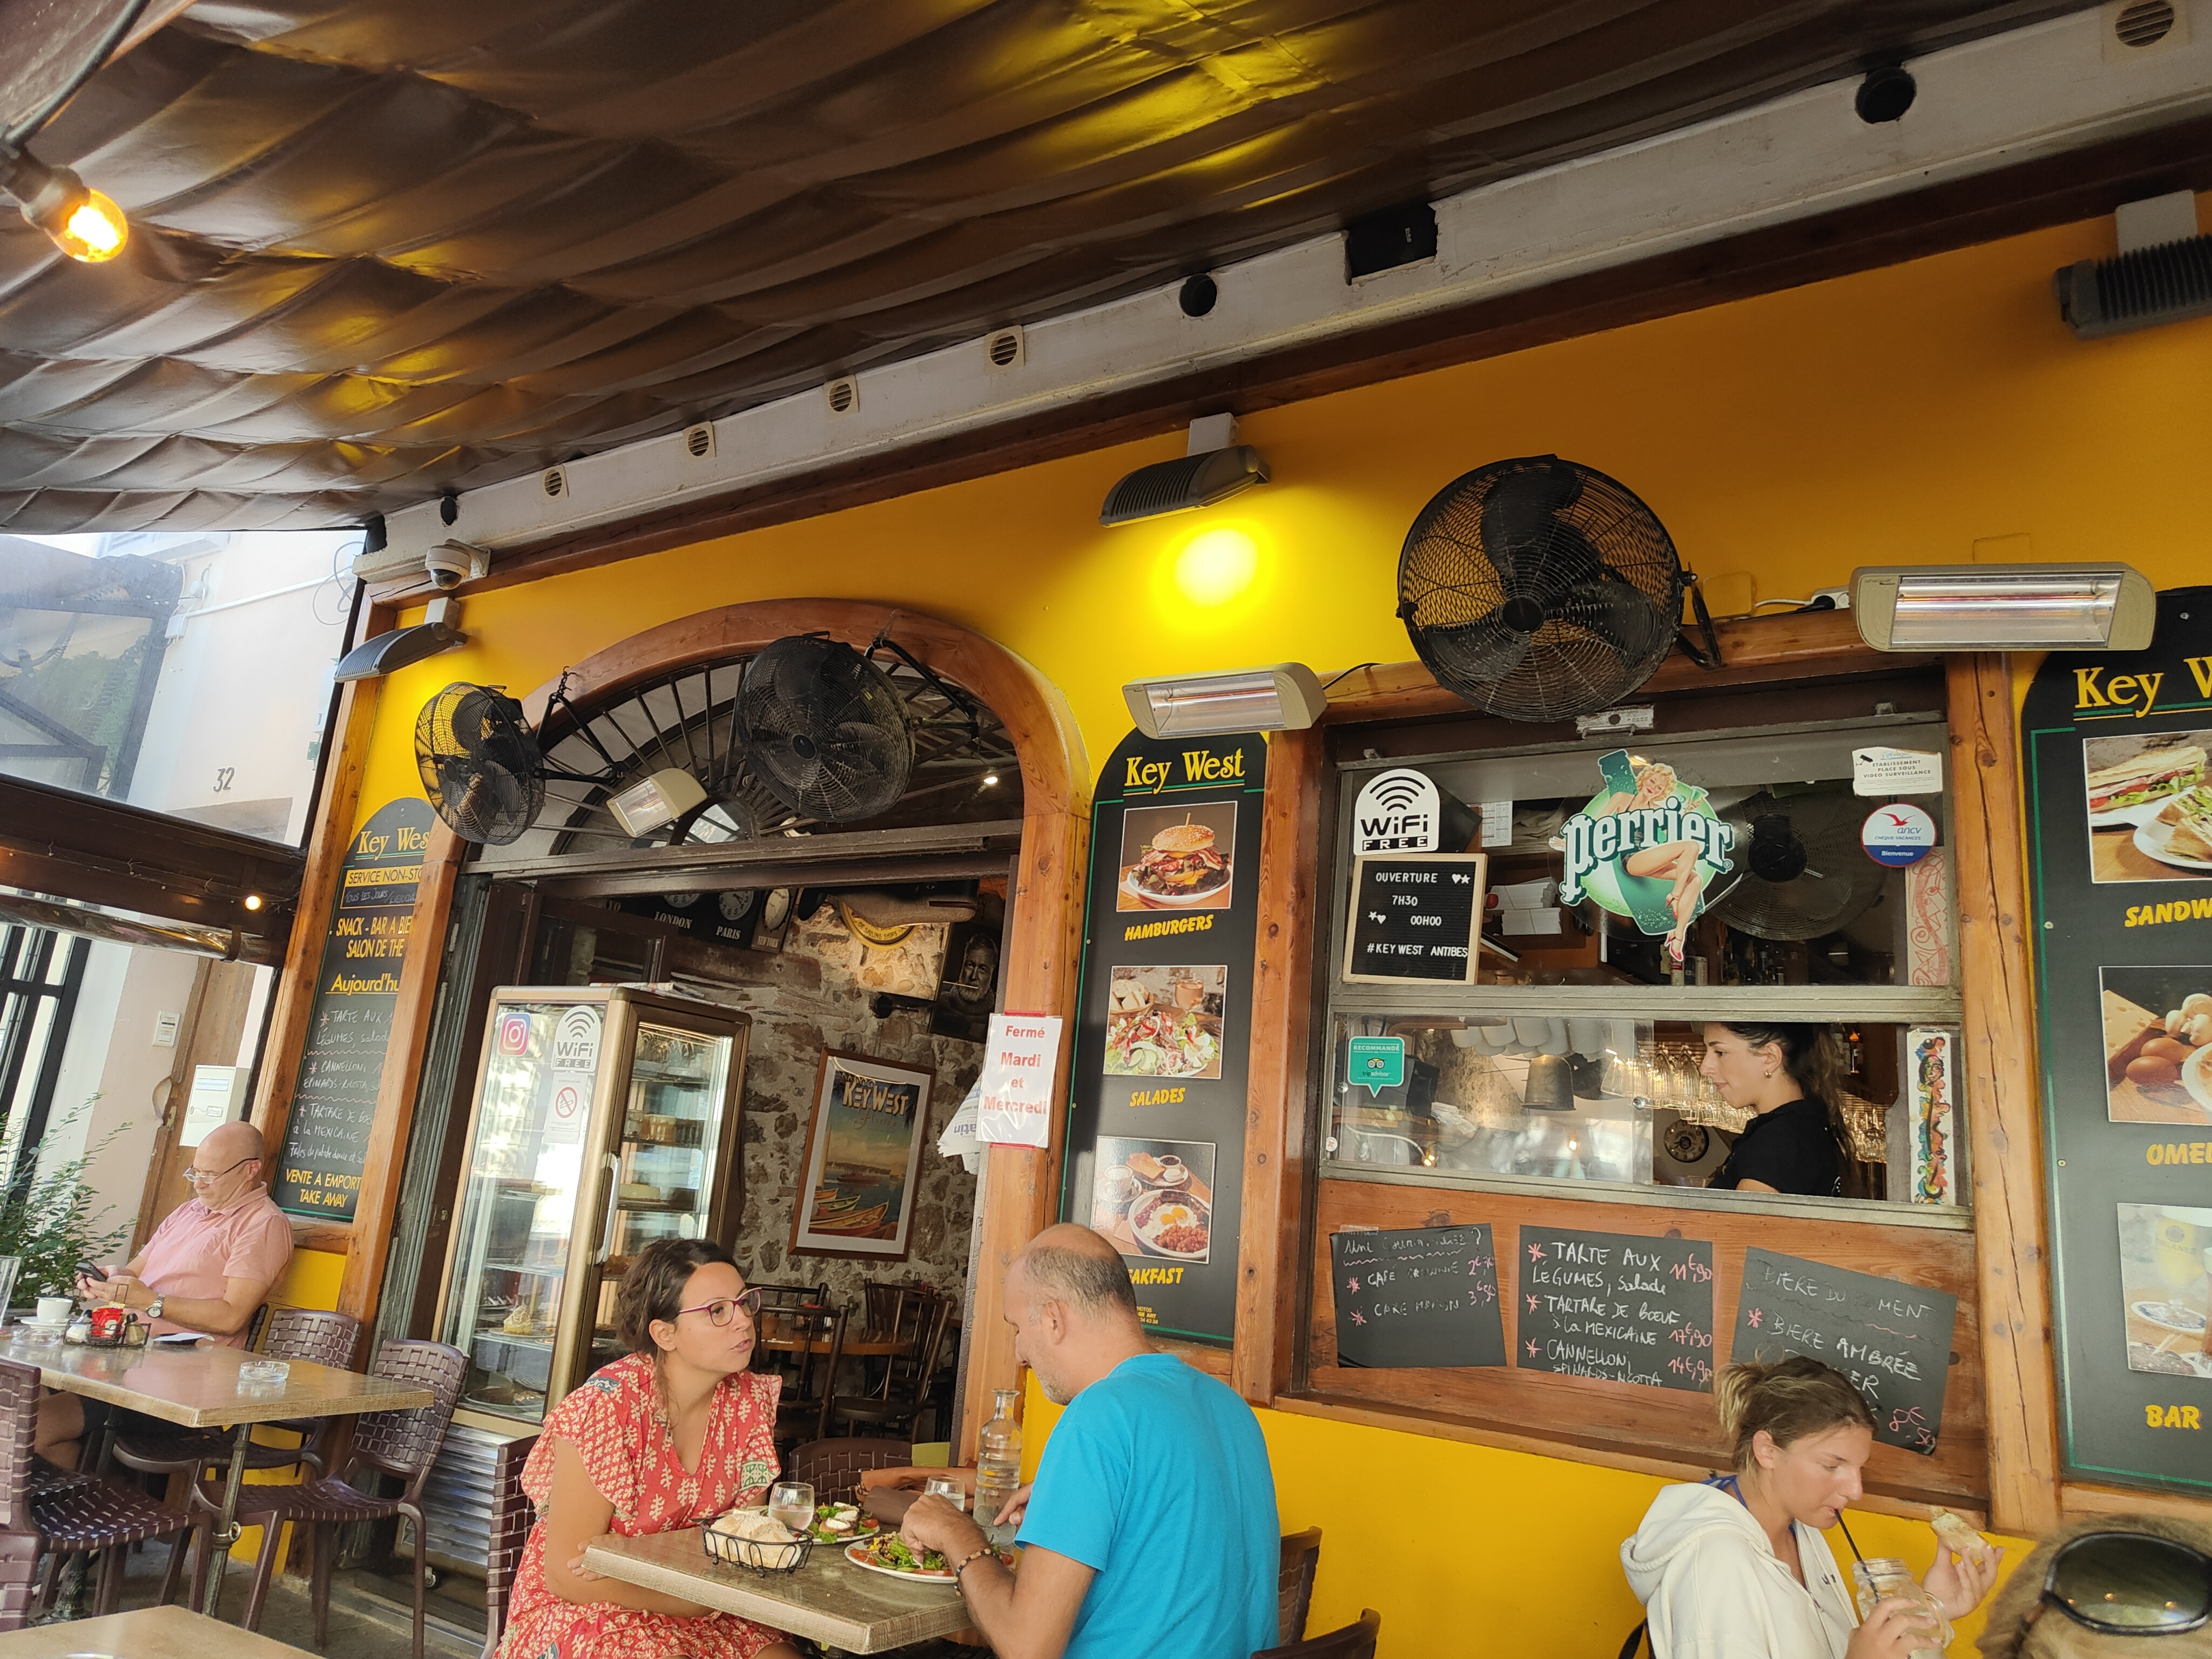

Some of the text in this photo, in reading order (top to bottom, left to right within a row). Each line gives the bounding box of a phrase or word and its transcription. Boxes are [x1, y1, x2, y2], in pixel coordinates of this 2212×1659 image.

[2073, 666, 2164, 718] Key
[213, 767, 235, 792] 32
[1124, 747, 1246, 794] Key West
[1360, 813, 1428, 837] WiFi
[356, 831, 390, 861] Key
[1363, 837, 1427, 851] FREE
[348, 871, 381, 885] SERVICE
[1375, 872, 1438, 884] OUVERTURE
[1392, 895, 1418, 907] 7H30
[336, 917, 365, 936] SNACK
[370, 916, 388, 935] BAR
[388, 916, 396, 934] A
[655, 911, 692, 929] LONDON
[1124, 914, 1214, 942] HAMBURGERS
[716, 926, 741, 940] PARIS
[757, 935, 767, 946] NEW
[884, 931, 898, 940] SHIPS
[346, 938, 404, 958] SALON DE THE
[1430, 946, 1468, 957] ANTIBES
[331, 1009, 359, 1023] TARTE
[363, 1009, 383, 1024] AUX
[1005, 1025, 1045, 1038] Fermé
[557, 1042, 594, 1057] WiFi
[556, 1059, 590, 1068] FREE
[1000, 1052, 1041, 1067] Mardi
[1011, 1077, 1024, 1088] et
[842, 1082, 909, 1116] KEY WEST
[983, 1095, 1047, 1116] Mercredi
[1129, 1087, 1186, 1107] SALADES
[309, 1103, 343, 1120] TARTARE
[304, 1120, 311, 1136] la
[286, 1168, 362, 1190] VENTE A EMPORT
[299, 1189, 348, 1208] TAKE AWAY
[1552, 1242, 1661, 1271] TARTE AUX
[1825, 1287, 1846, 1302] DU
[1544, 1294, 1606, 1317] TARTARE
[1611, 1301, 1629, 1319] DE
[1553, 1313, 1561, 1329] à
[1563, 1316, 1582, 1333] la
[2145, 1404, 2201, 1431] BAR
